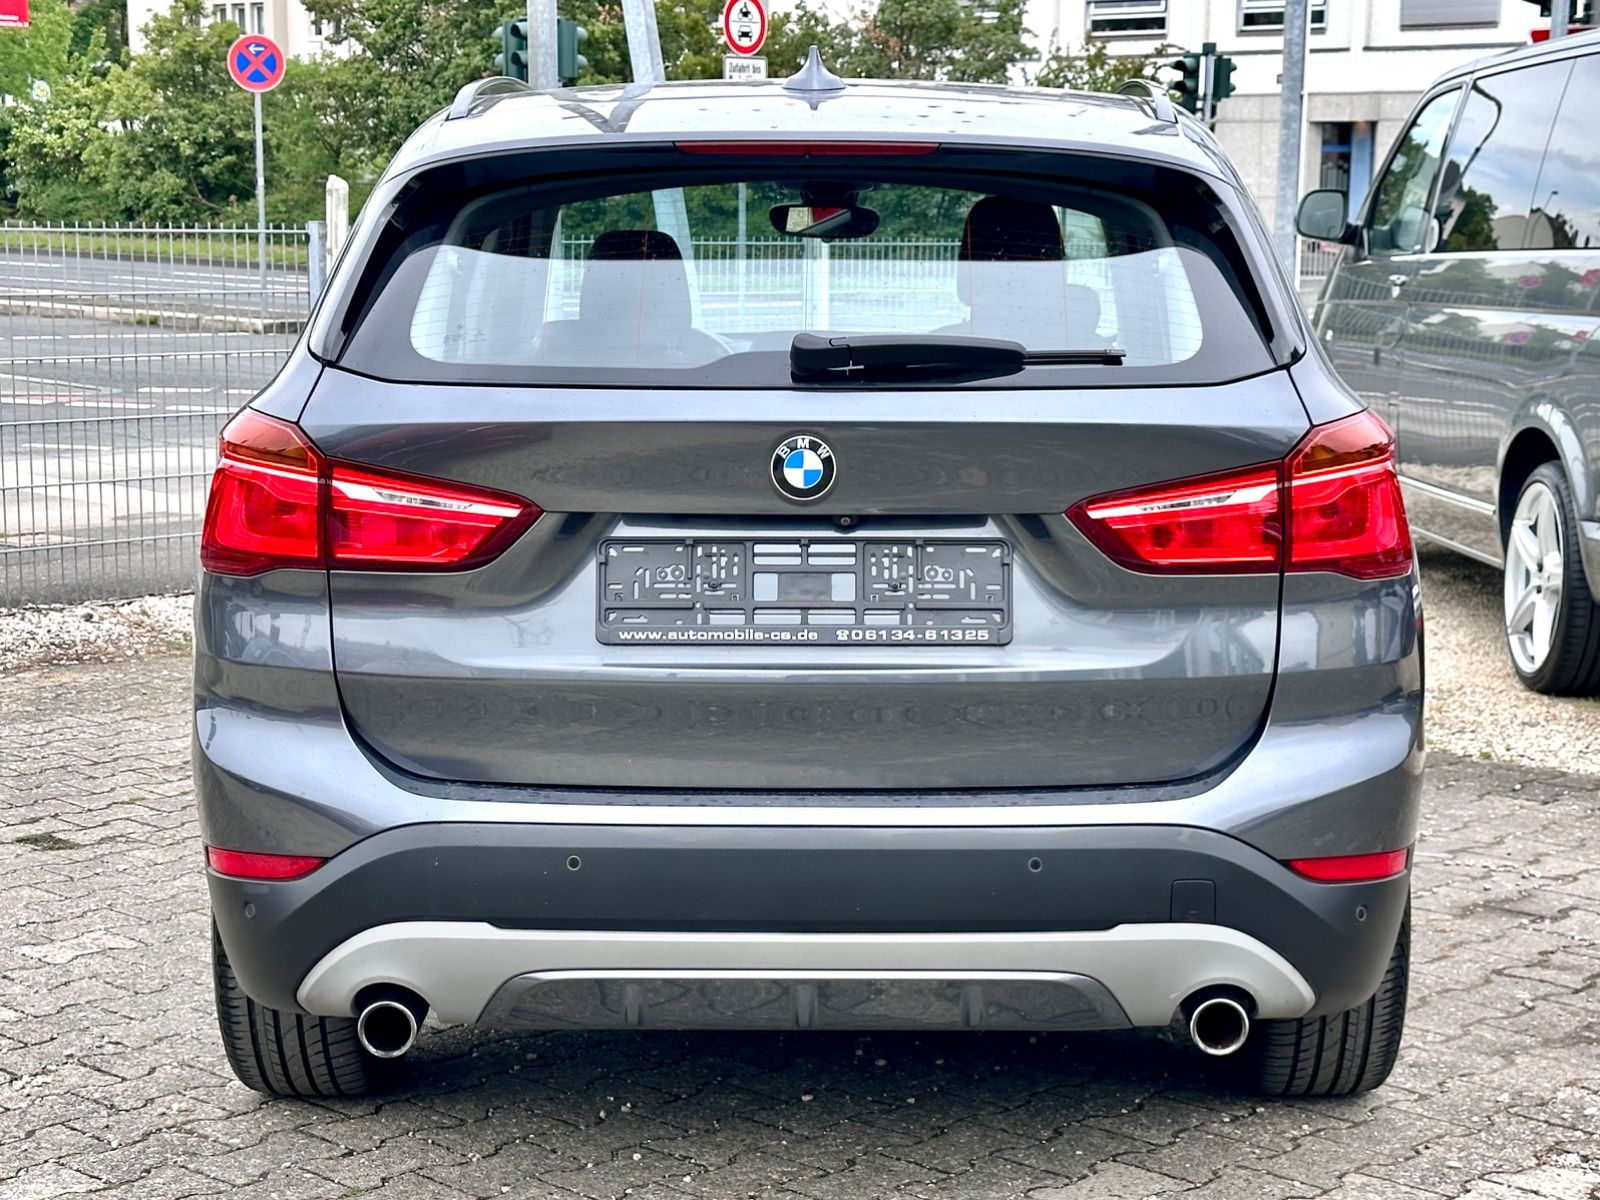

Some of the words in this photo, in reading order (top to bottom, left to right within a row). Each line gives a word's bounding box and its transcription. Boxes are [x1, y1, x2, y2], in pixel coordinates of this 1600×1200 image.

[777, 438, 831, 460] BMW
[618, 629, 819, 641] www.automobile-cs.de
[851, 629, 990, 641] 06134-61325
